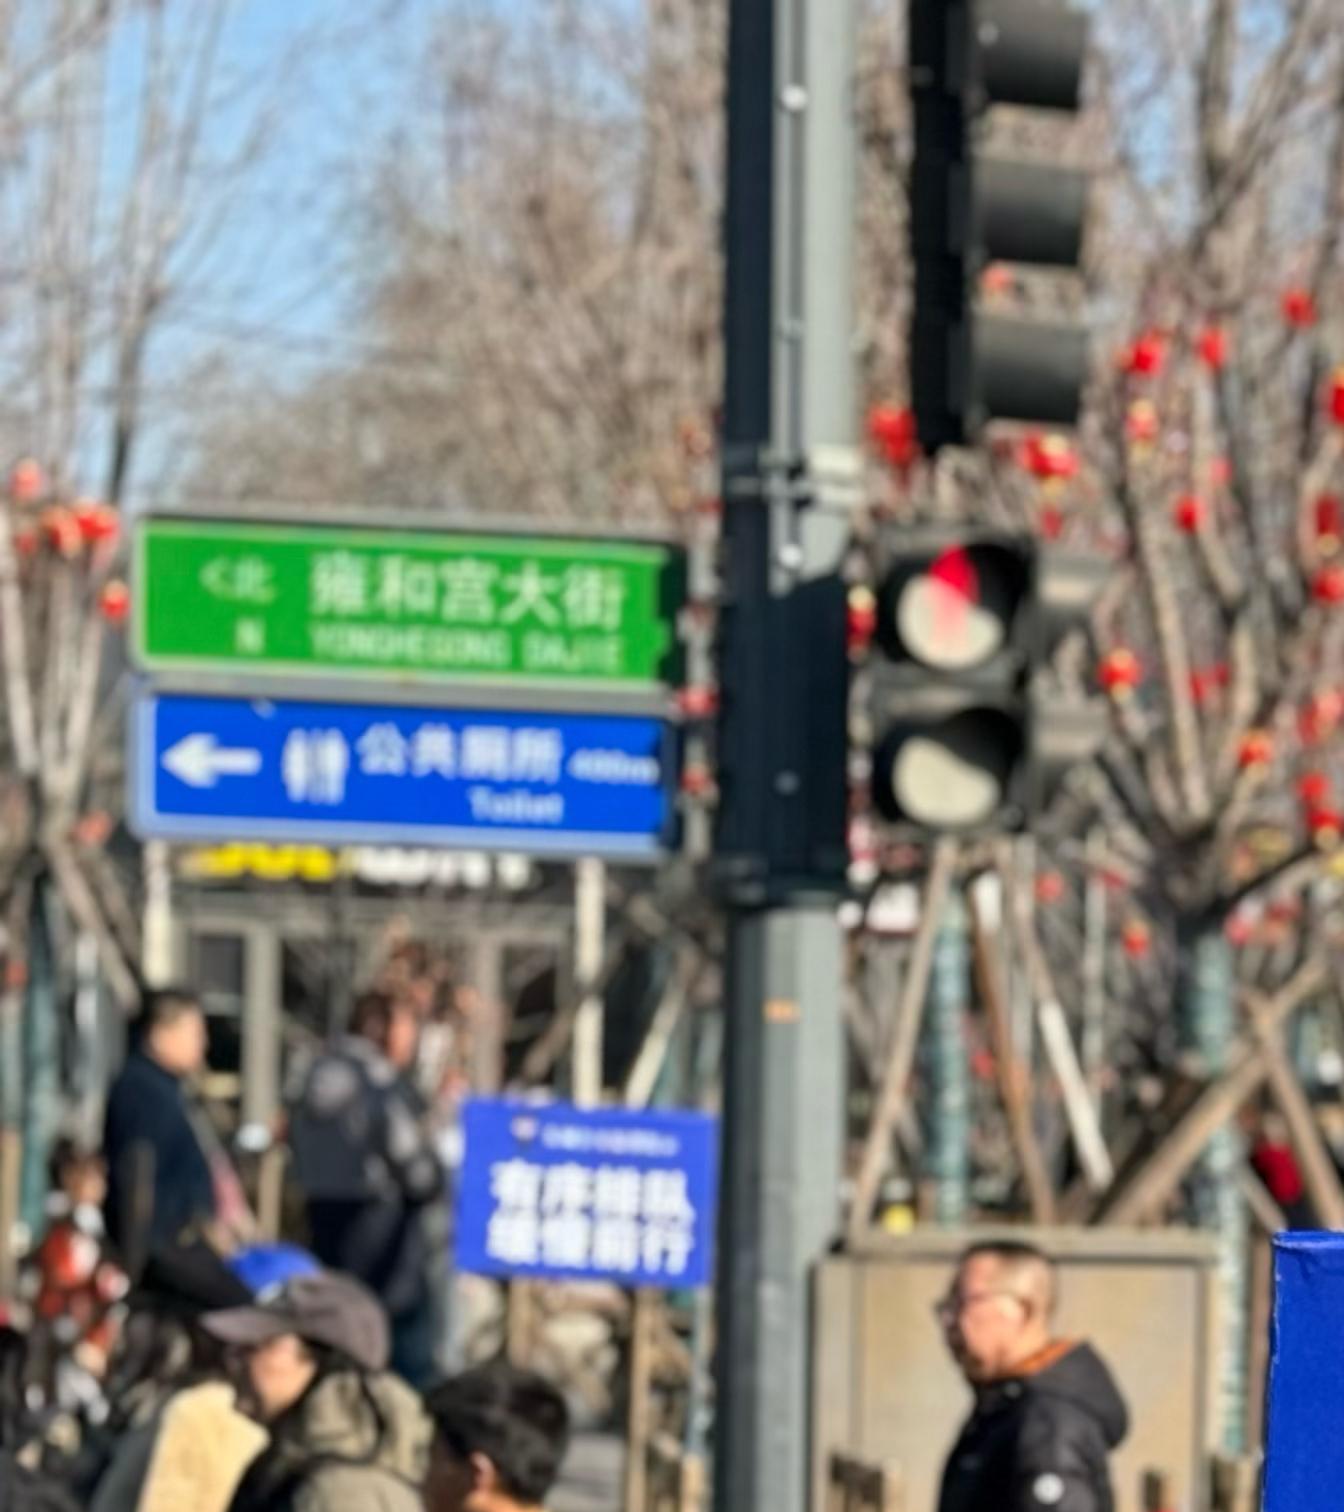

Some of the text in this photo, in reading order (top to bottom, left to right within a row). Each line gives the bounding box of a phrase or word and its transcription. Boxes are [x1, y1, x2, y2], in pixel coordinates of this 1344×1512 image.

[311, 552, 625, 630] 雍和宫大街
